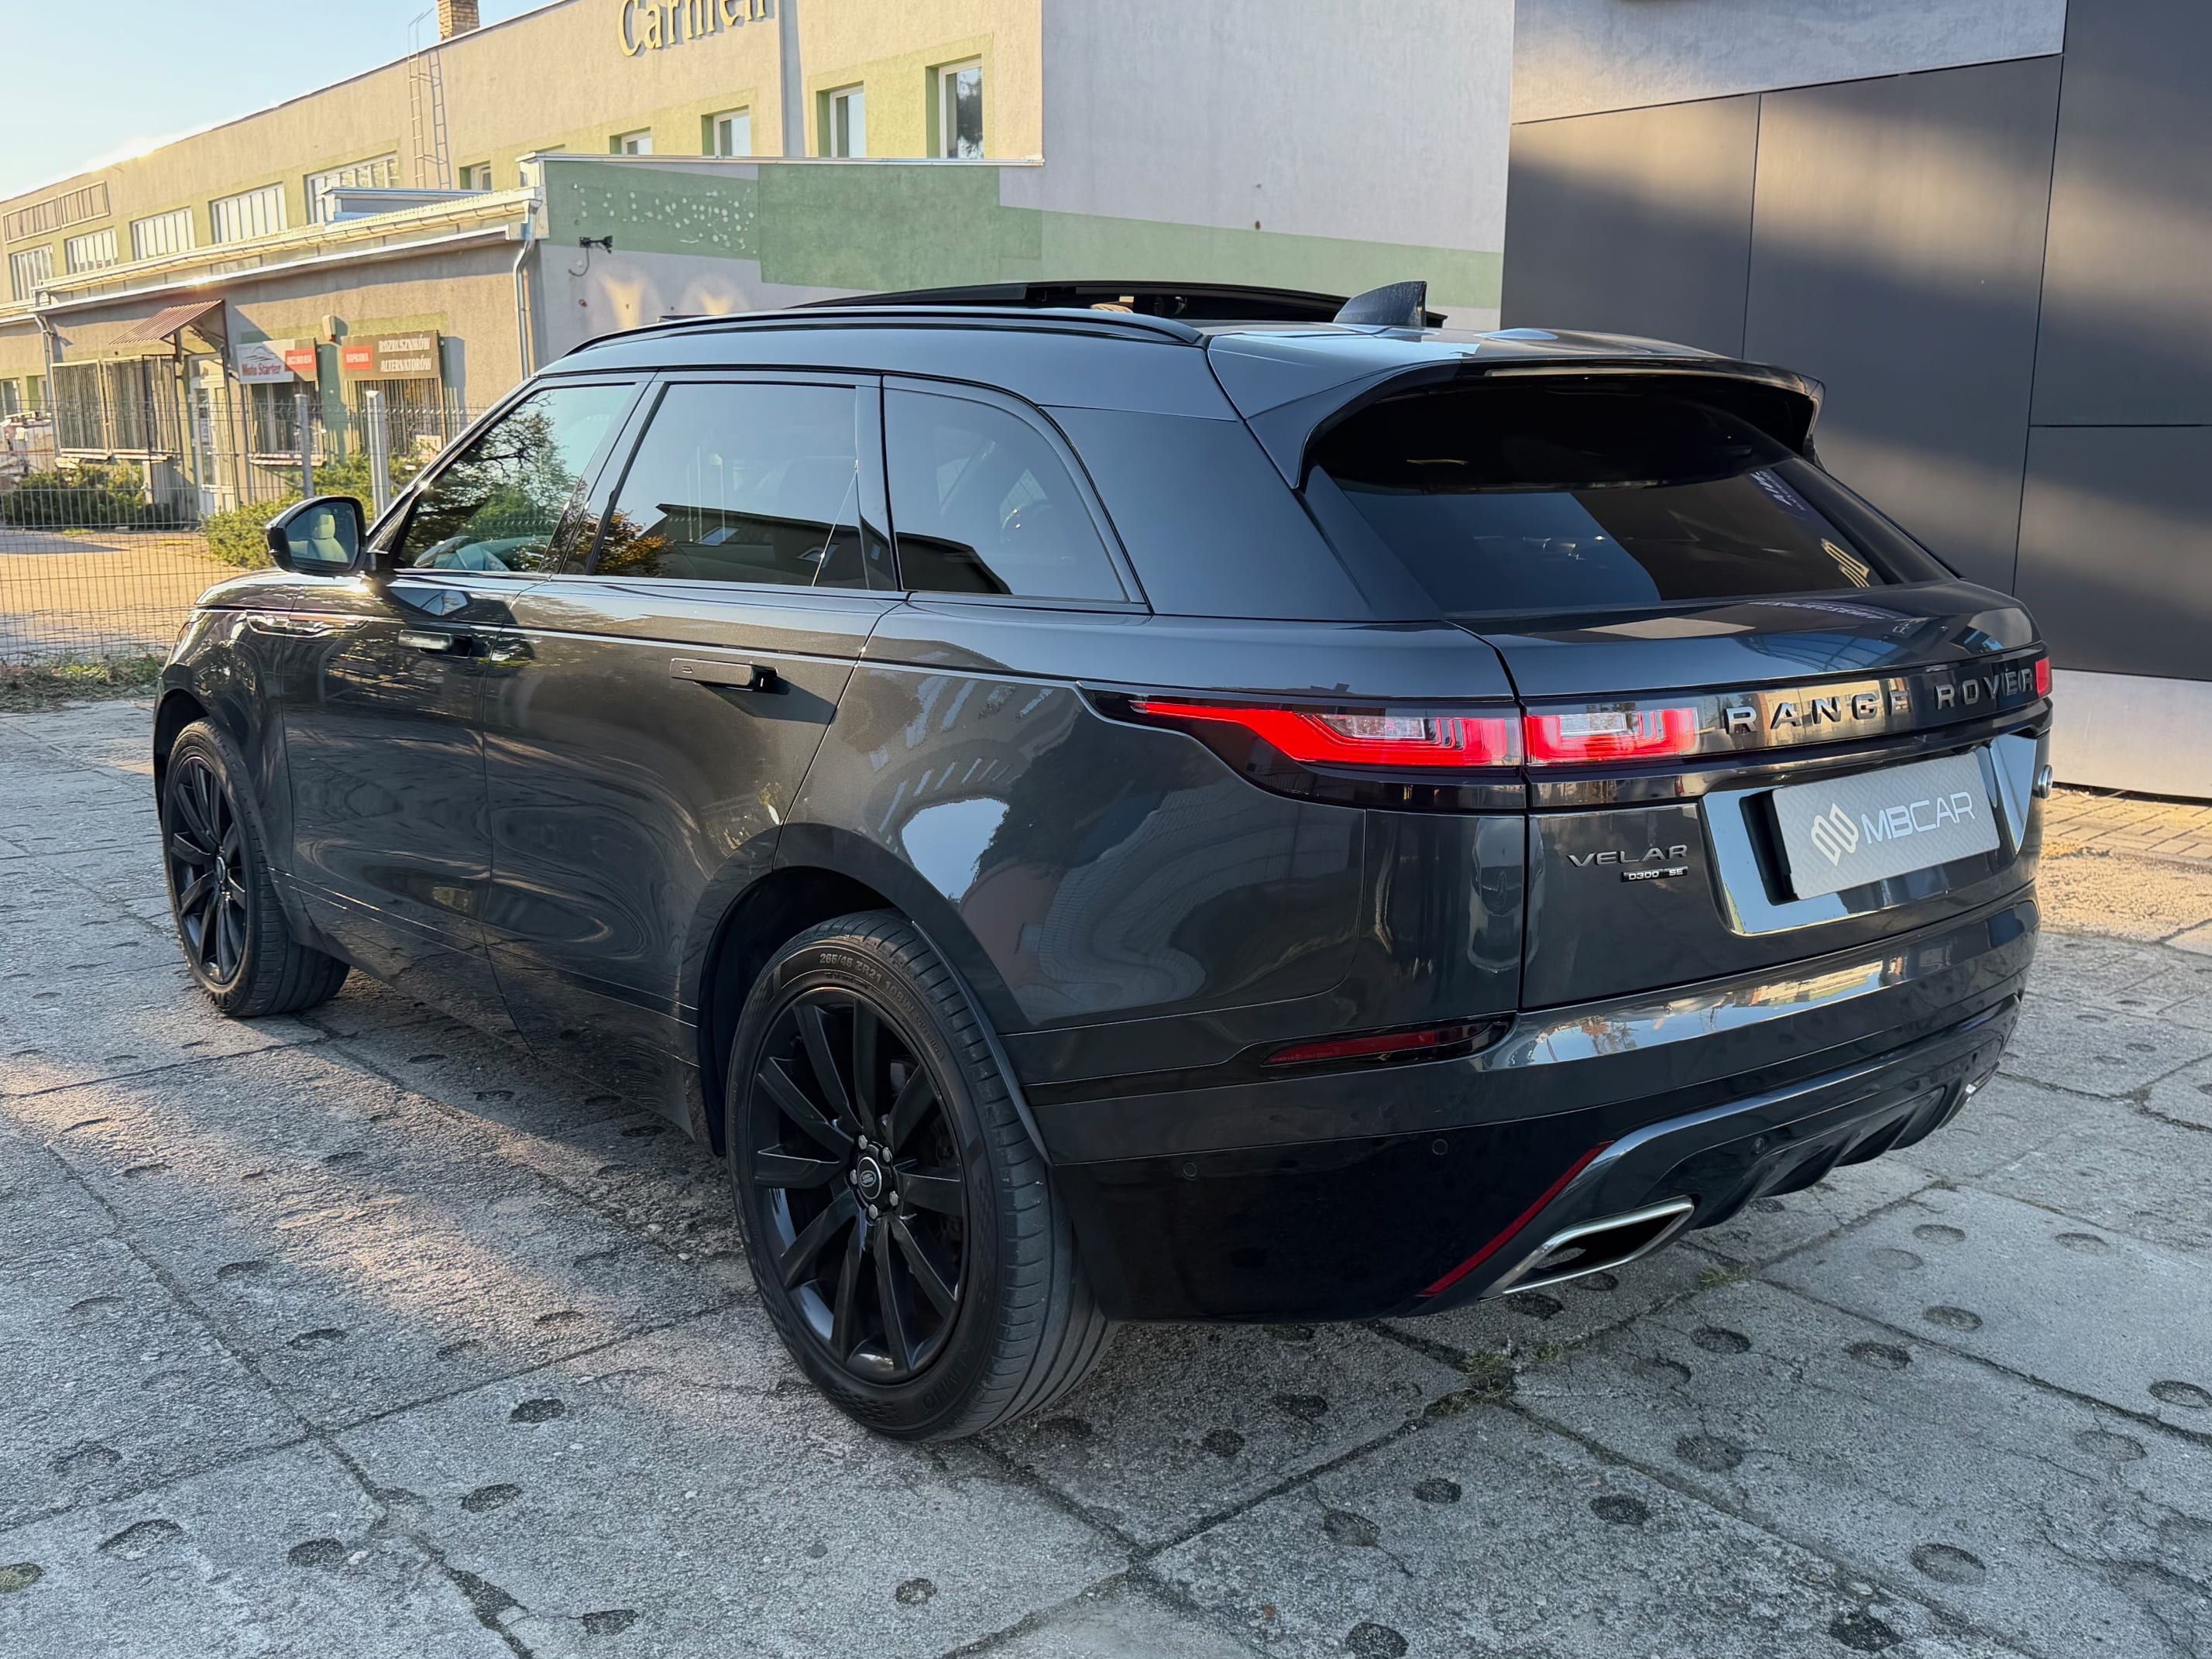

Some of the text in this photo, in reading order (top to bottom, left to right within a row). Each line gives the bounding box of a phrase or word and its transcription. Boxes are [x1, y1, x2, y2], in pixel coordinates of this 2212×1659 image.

[258, 362, 281, 376] Starter
[1726, 668, 2033, 735] RANGE ROVER
[1861, 792, 1976, 844] MBCAR
[1568, 844, 1688, 867] VELAR
[1628, 871, 1660, 881] D300
[819, 953, 853, 967] 265/45
[856, 960, 882, 983] ZR21
